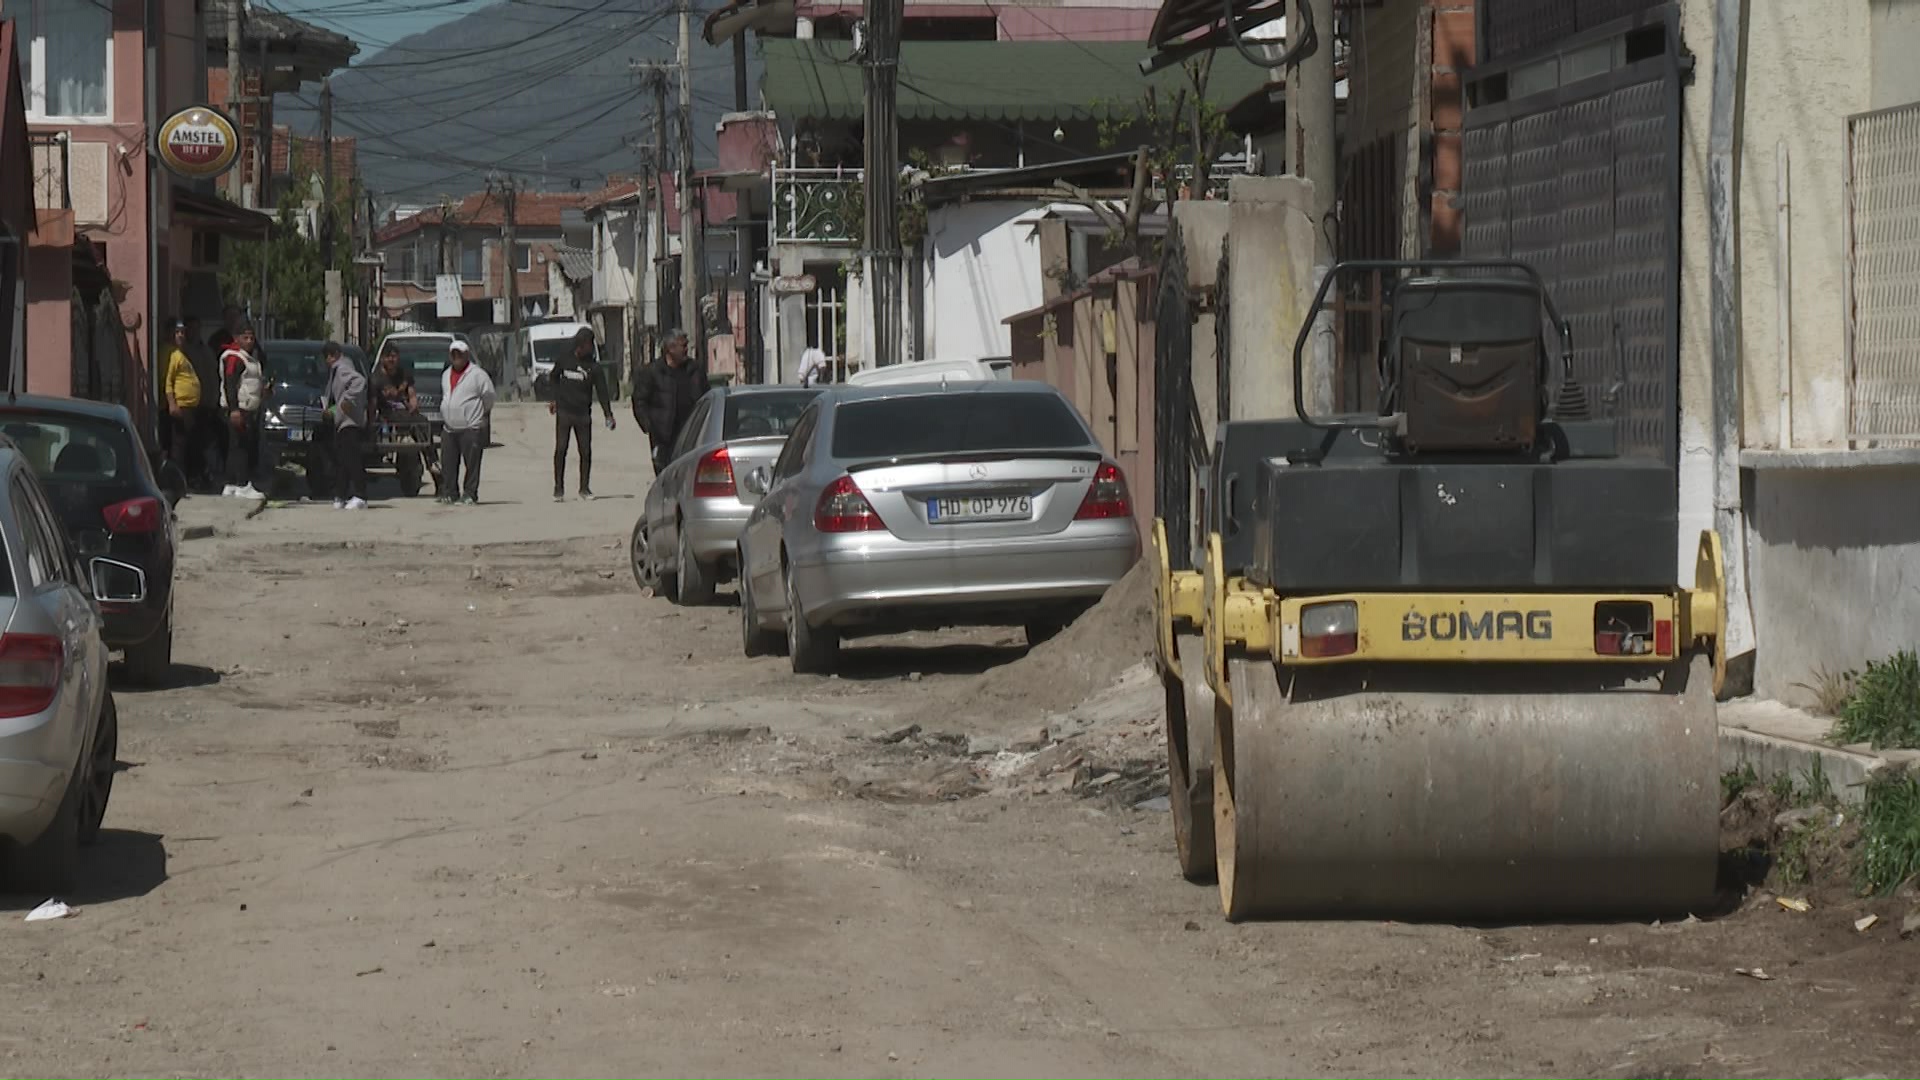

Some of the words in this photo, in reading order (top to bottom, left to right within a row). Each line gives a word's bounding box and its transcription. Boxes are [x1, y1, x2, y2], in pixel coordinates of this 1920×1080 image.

[172, 129, 222, 143] AMSTEL
[939, 499, 960, 516] HD
[972, 497, 994, 514] OP
[998, 496, 1029, 513] 976
[1402, 610, 1552, 641] BOMAG
